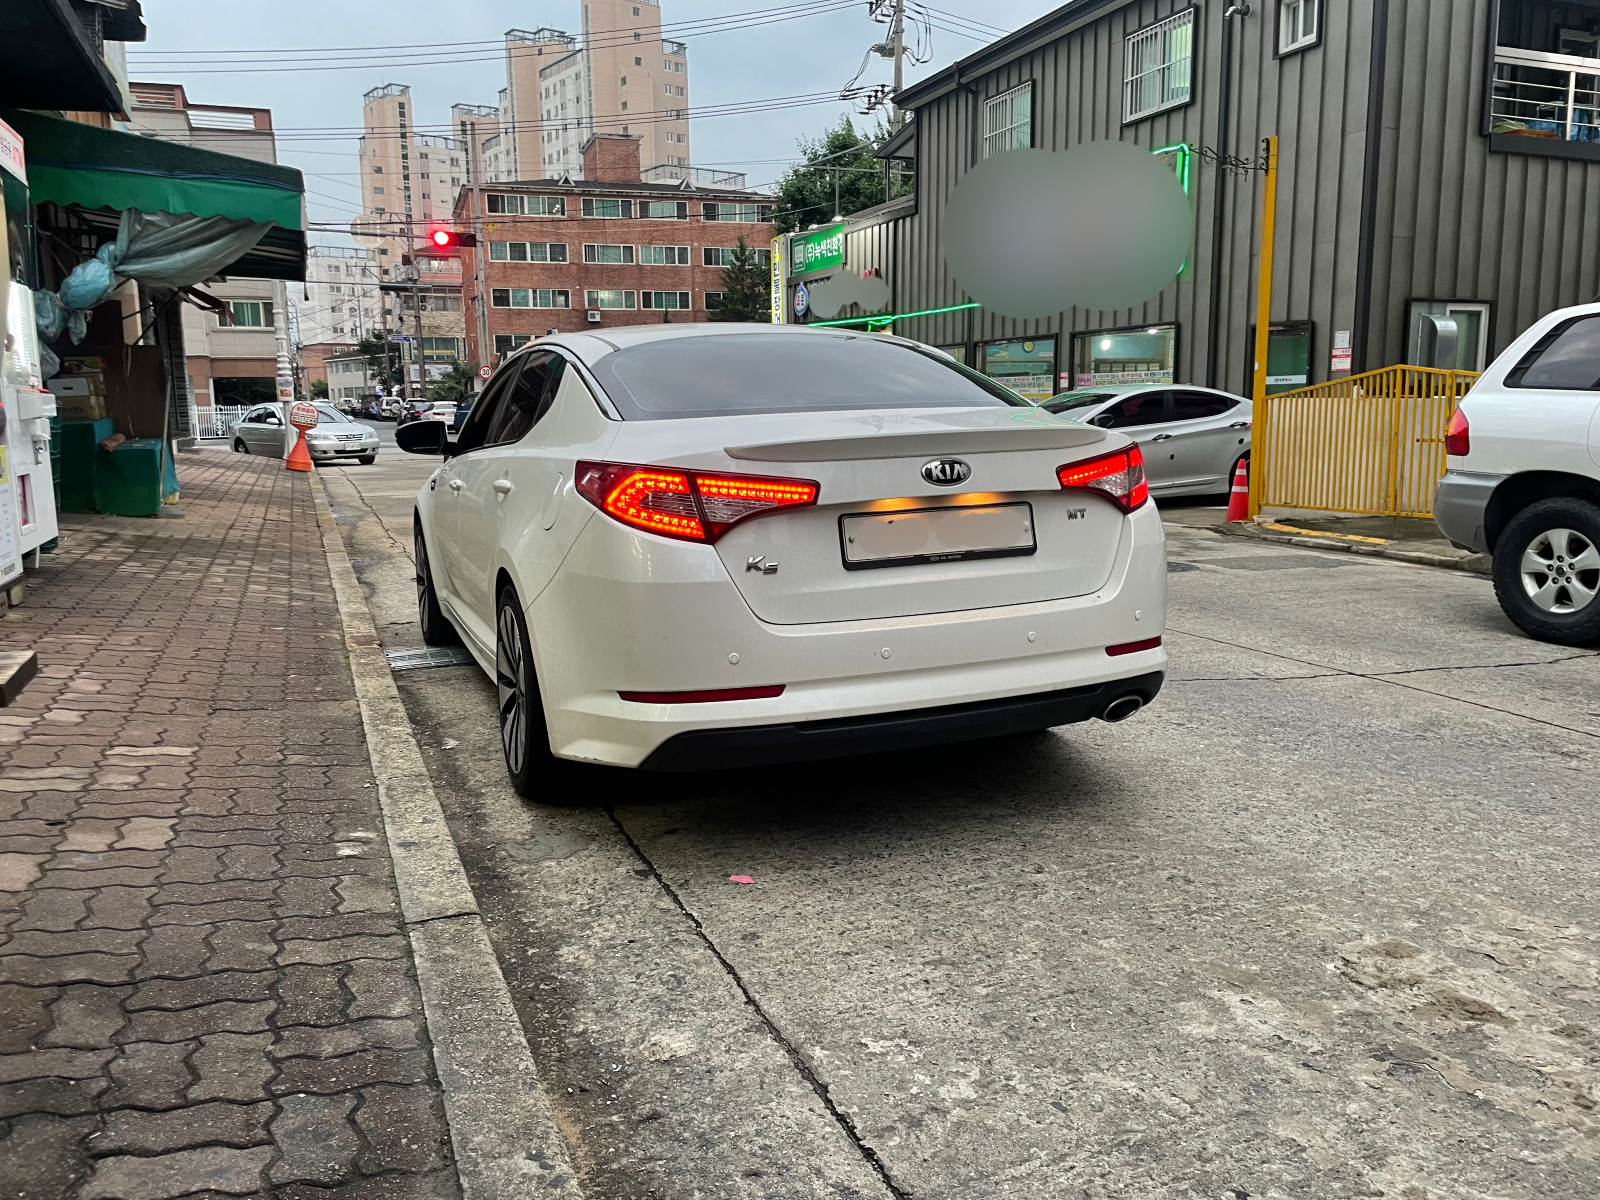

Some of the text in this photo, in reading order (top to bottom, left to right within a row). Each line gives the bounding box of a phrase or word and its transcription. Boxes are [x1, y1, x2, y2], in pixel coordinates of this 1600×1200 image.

[931, 463, 966, 481] KIA
[1066, 507, 1087, 521] MT
[745, 555, 780, 575] K5
